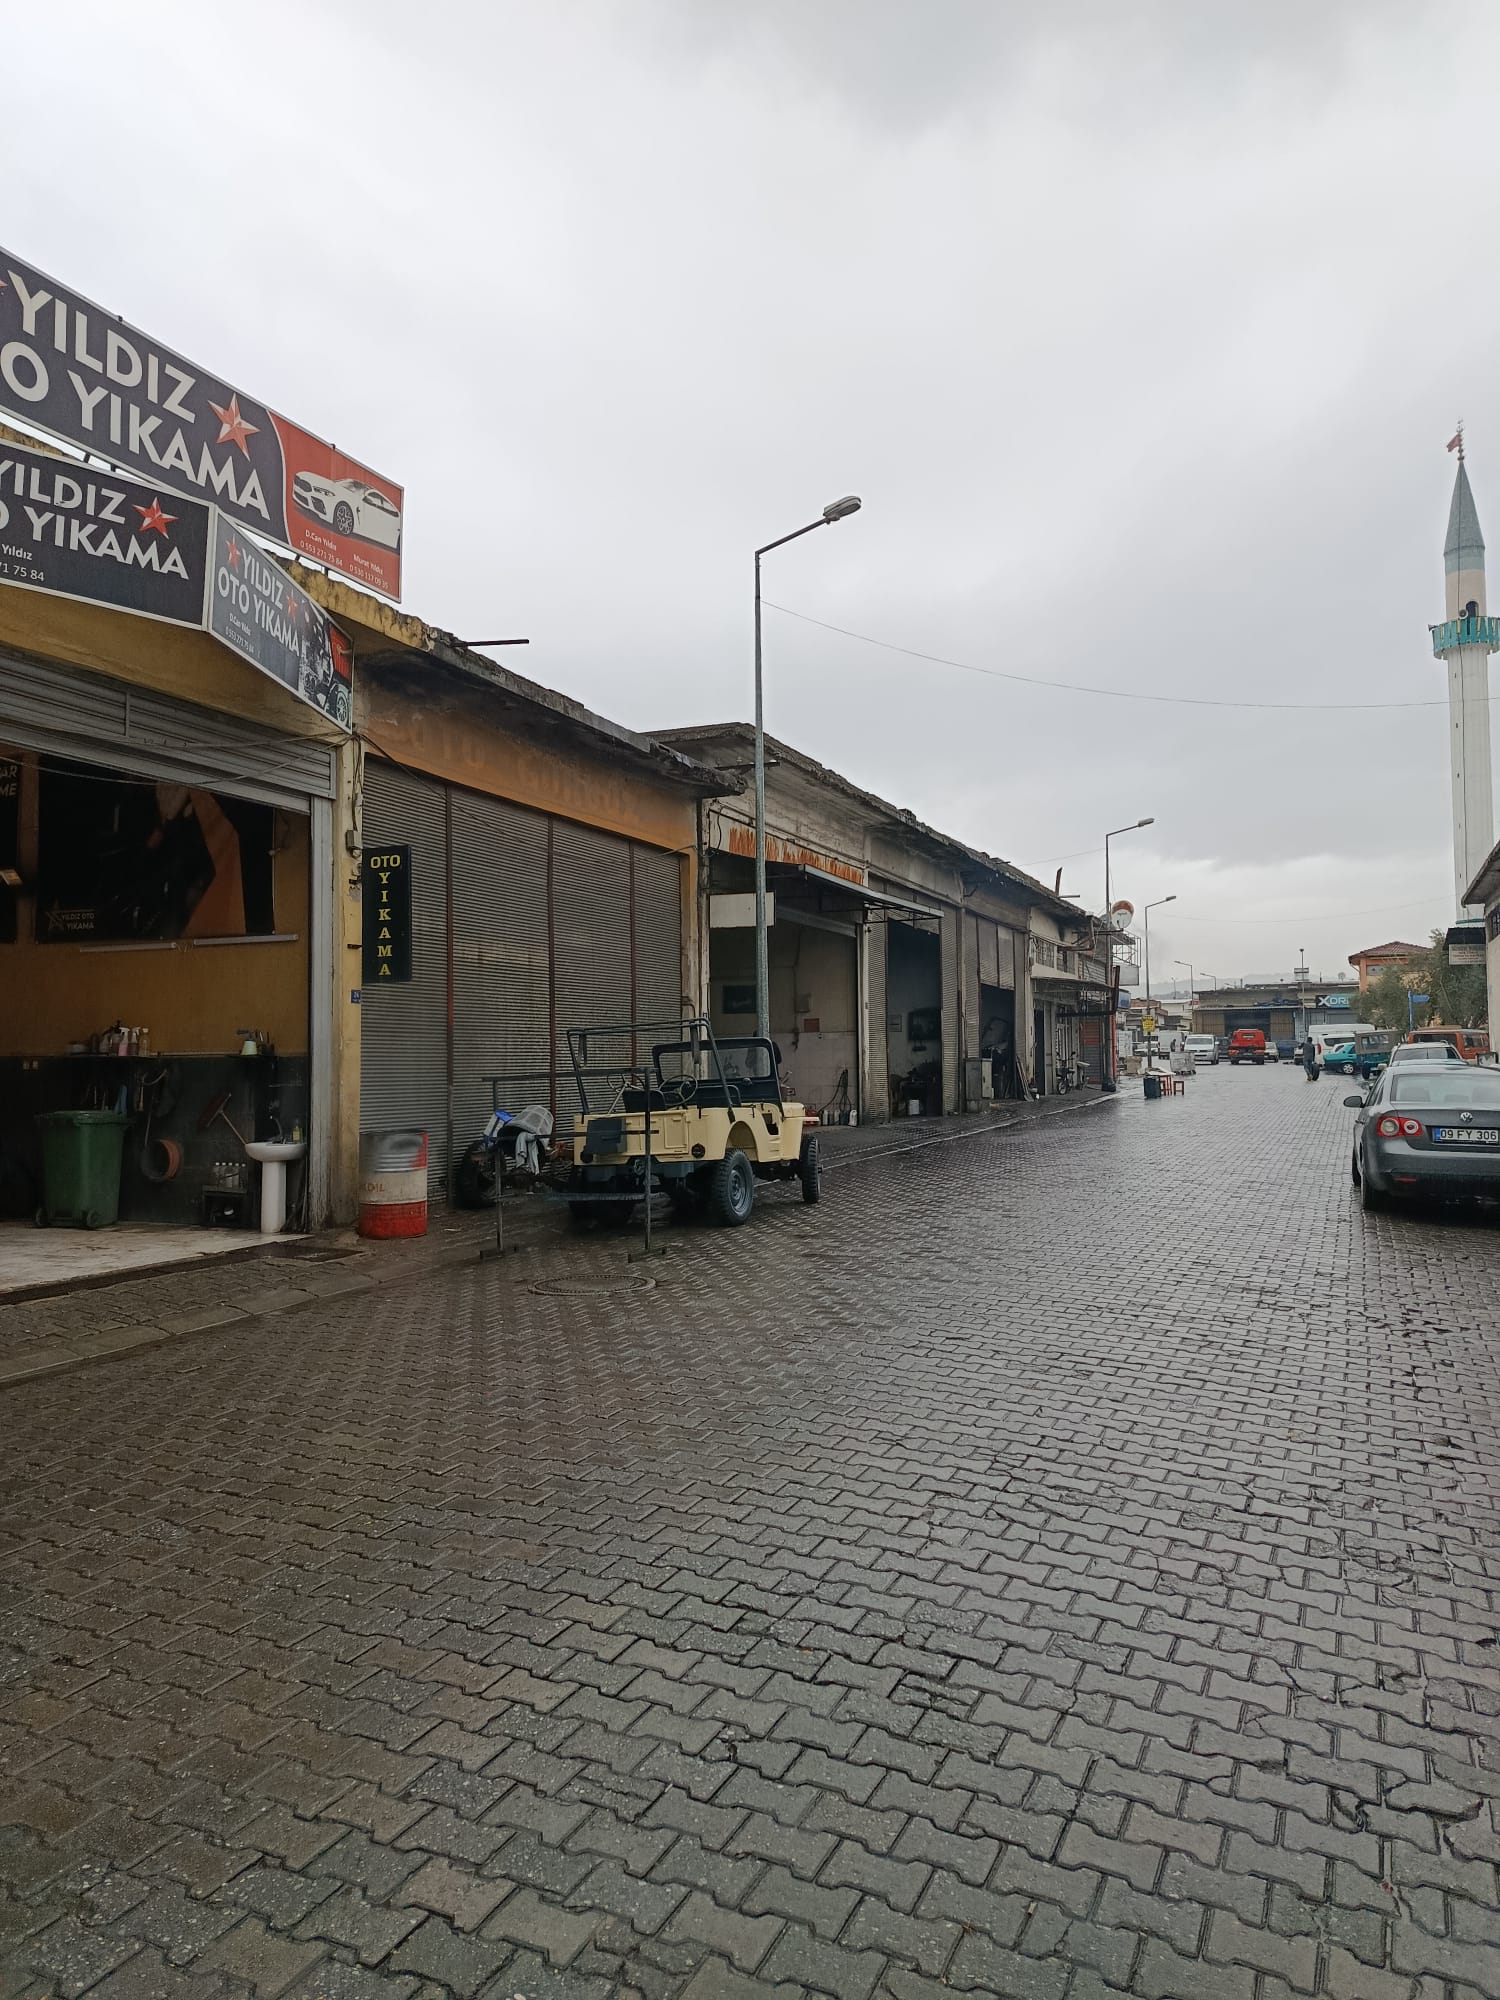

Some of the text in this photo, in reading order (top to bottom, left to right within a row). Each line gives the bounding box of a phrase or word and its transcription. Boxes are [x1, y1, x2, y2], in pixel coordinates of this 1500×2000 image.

[8, 270, 196, 424] YILDIZ
[67, 369, 270, 521] YIKAMA
[2, 543, 33, 561] Yıldız
[13, 565, 27, 577] 75
[30, 569, 45, 582] 84
[23, 505, 189, 580] YIKAMA
[242, 548, 284, 610] YILDIZ
[218, 567, 300, 657] OTO YIKAMA
[370, 855, 401, 869] OTO
[81, 912, 95, 920] OTO
[377, 872, 393, 976] YIKAMA
[1440, 1129, 1497, 1141] 09 FY 306
